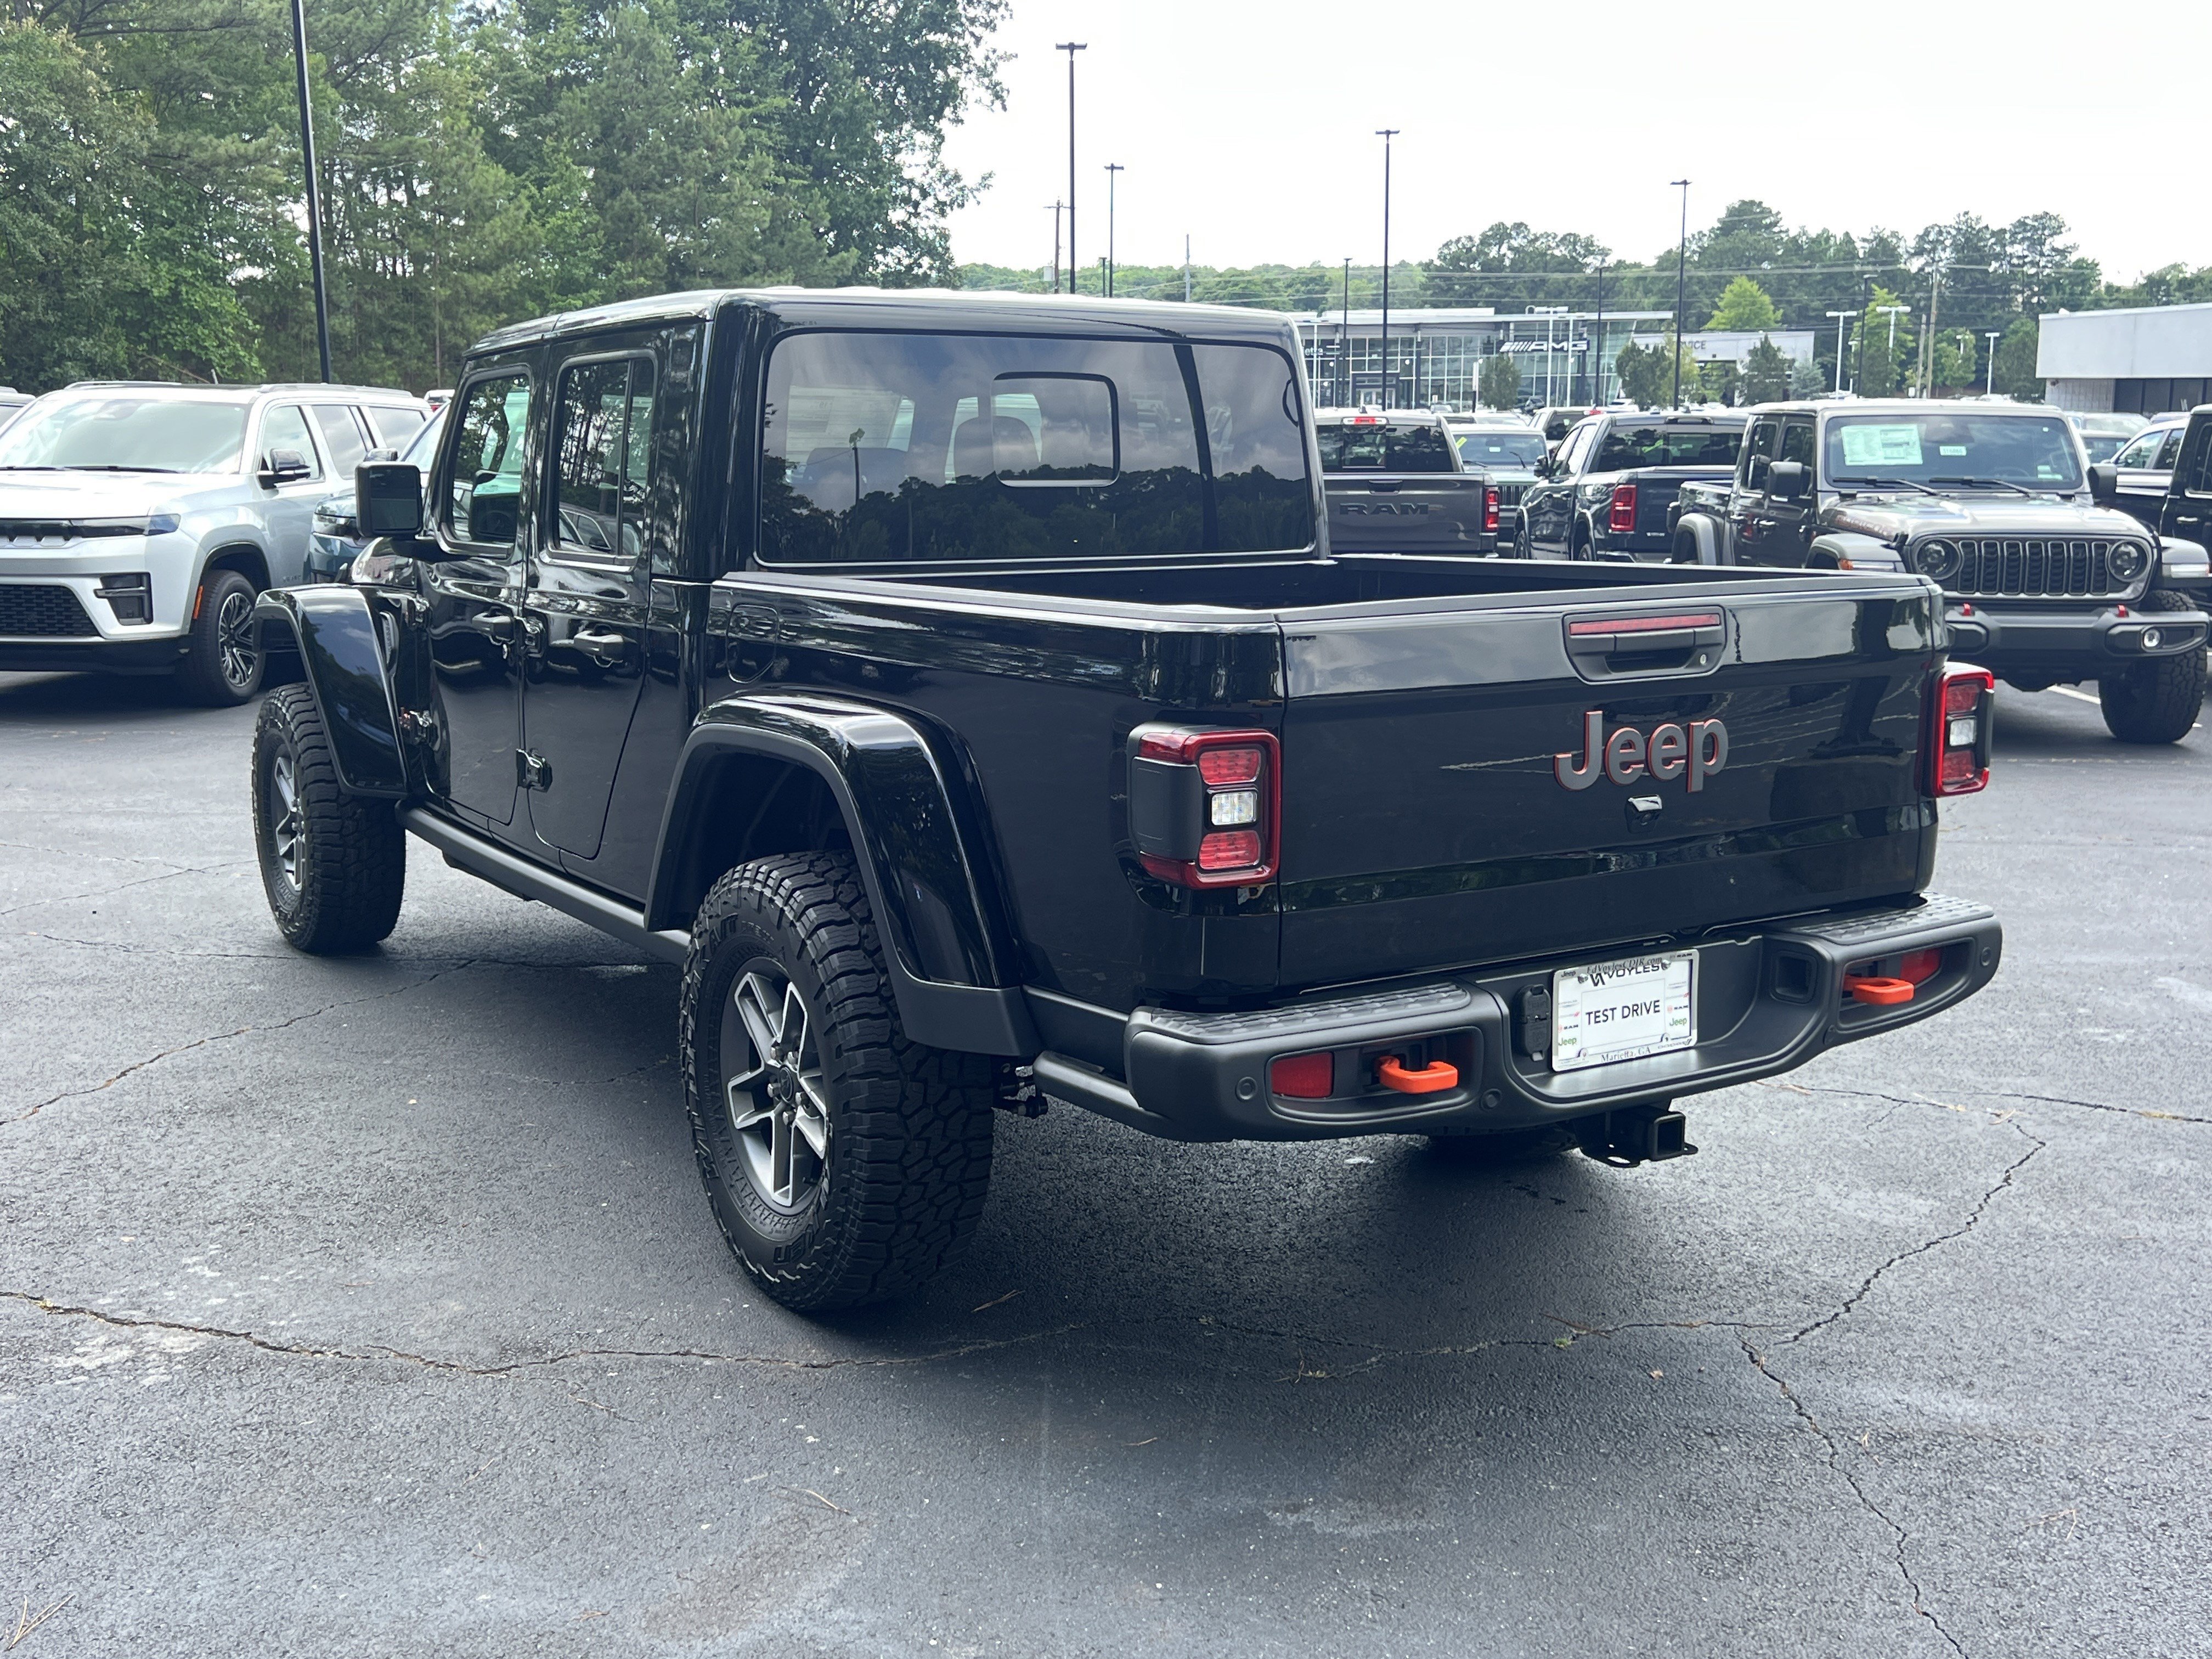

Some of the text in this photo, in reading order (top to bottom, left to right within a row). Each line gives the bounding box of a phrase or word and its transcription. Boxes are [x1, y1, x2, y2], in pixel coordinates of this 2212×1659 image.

[1527, 335, 1588, 351] AMG
[1339, 503, 1429, 515] RAM
[1554, 710, 1729, 793] Jeep
[1608, 964, 1660, 979] VOYLES
[1585, 1000, 1660, 1025] TEST DRIVE
[1669, 1018, 1687, 1026] Jeep
[1558, 1037, 1577, 1046] Jeep
[1638, 1046, 1651, 1056] GA
